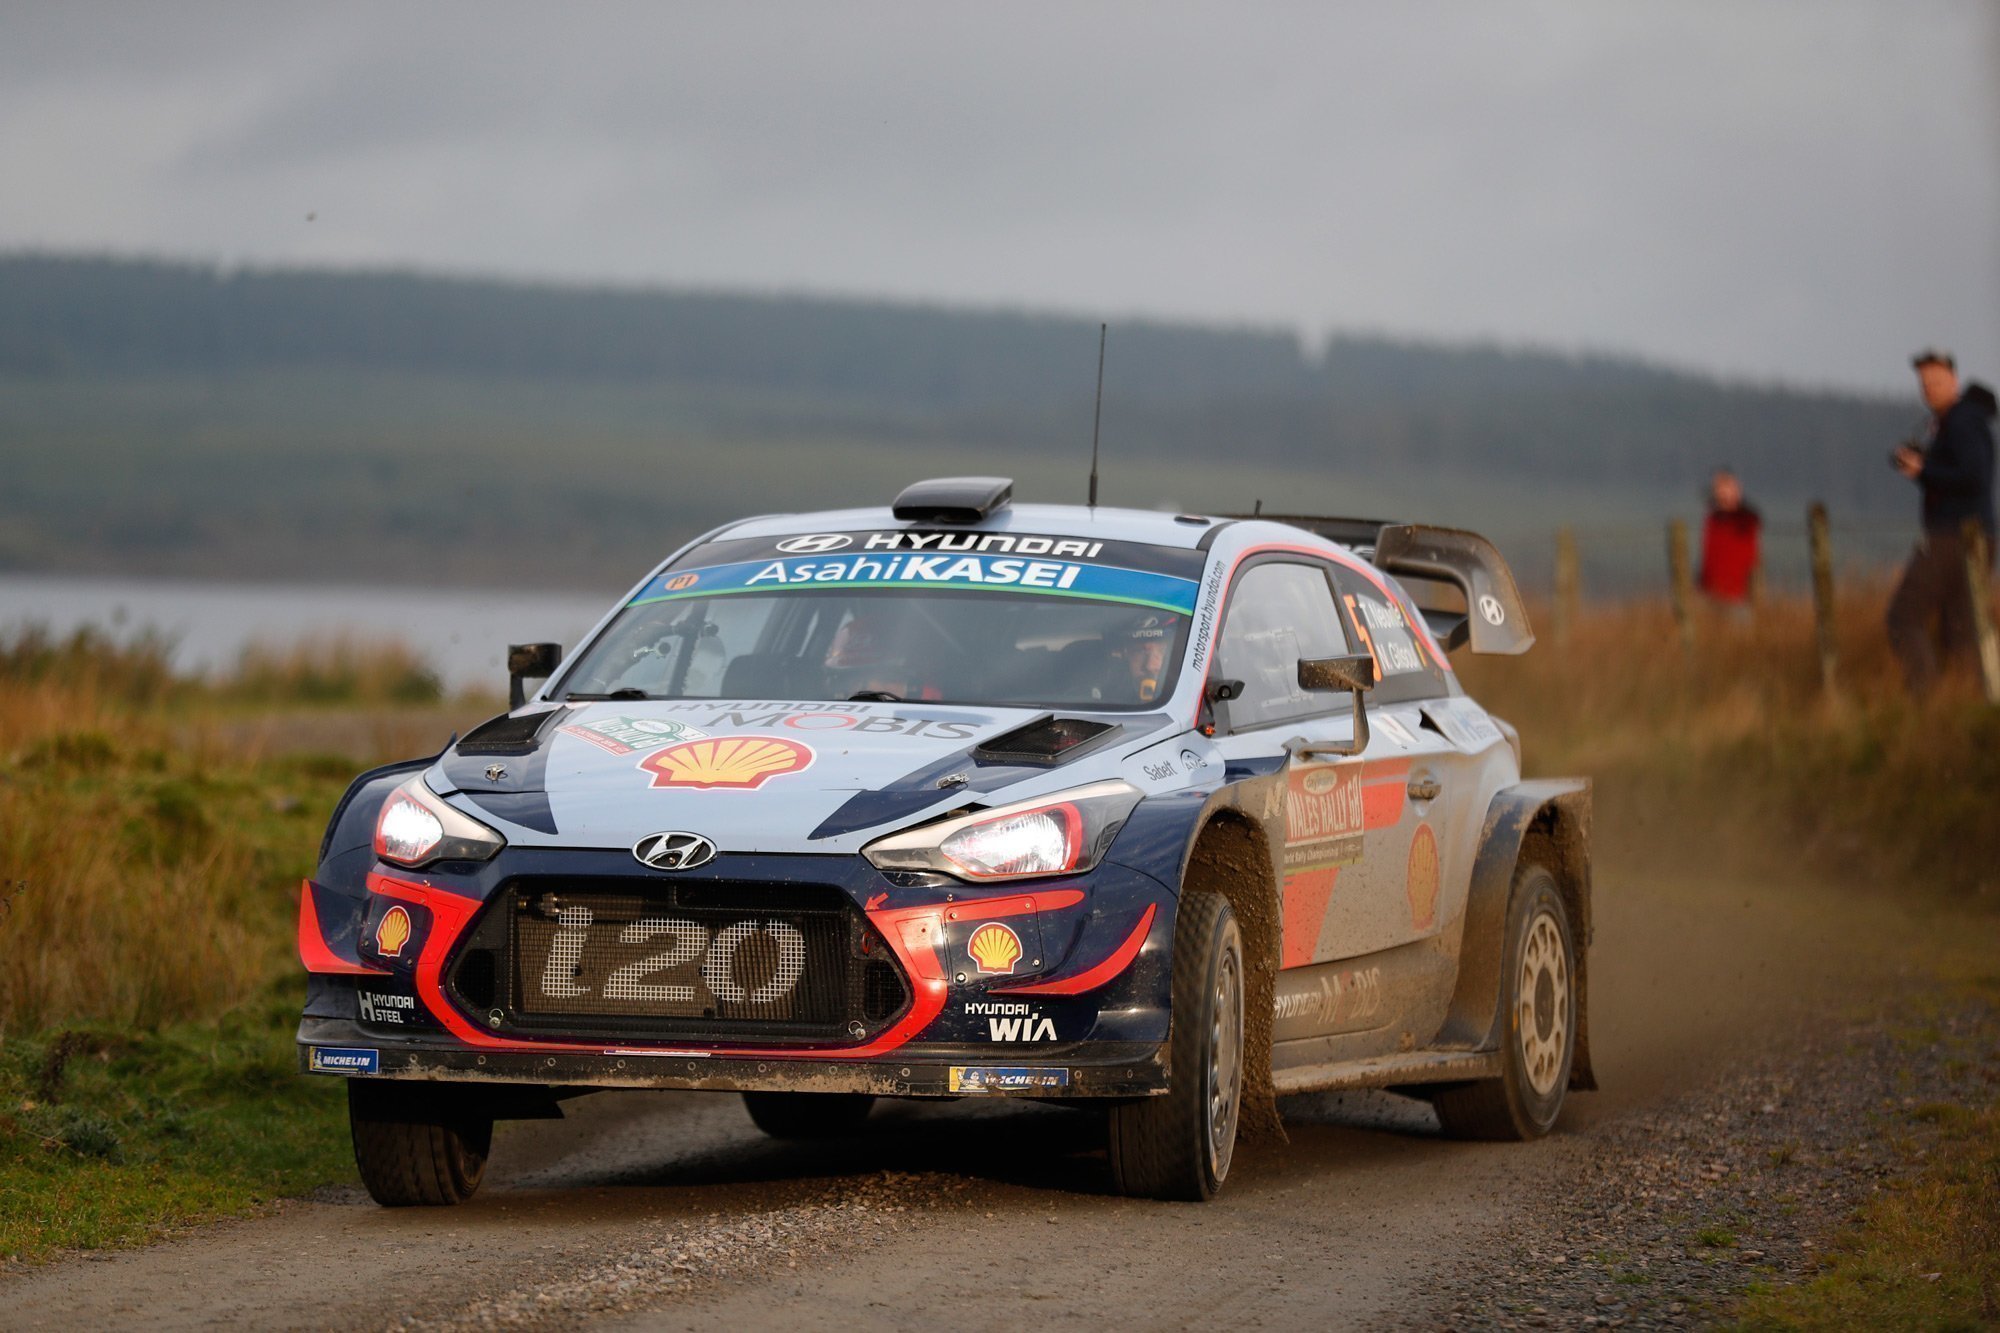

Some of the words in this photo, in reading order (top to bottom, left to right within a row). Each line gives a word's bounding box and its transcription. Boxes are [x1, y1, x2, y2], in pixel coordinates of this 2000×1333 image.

[864, 533, 1103, 558] HYUNDAI
[670, 576, 693, 589] P1
[1192, 560, 1226, 672] motorsport.hyundai.com
[667, 702, 872, 714] HYUNDAI
[701, 711, 982, 740] MOBIS
[1143, 760, 1178, 781] Sabelt
[1286, 789, 1319, 838] WALES
[1320, 785, 1347, 833] RALLY
[541, 905, 806, 1003] i20
[372, 993, 414, 1009] HYUNDAI
[965, 1003, 1029, 1015] HYUNDAI
[375, 1009, 404, 1023] STEEL
[989, 1013, 1057, 1041] WIA
[323, 1056, 370, 1066] MICHELIN
